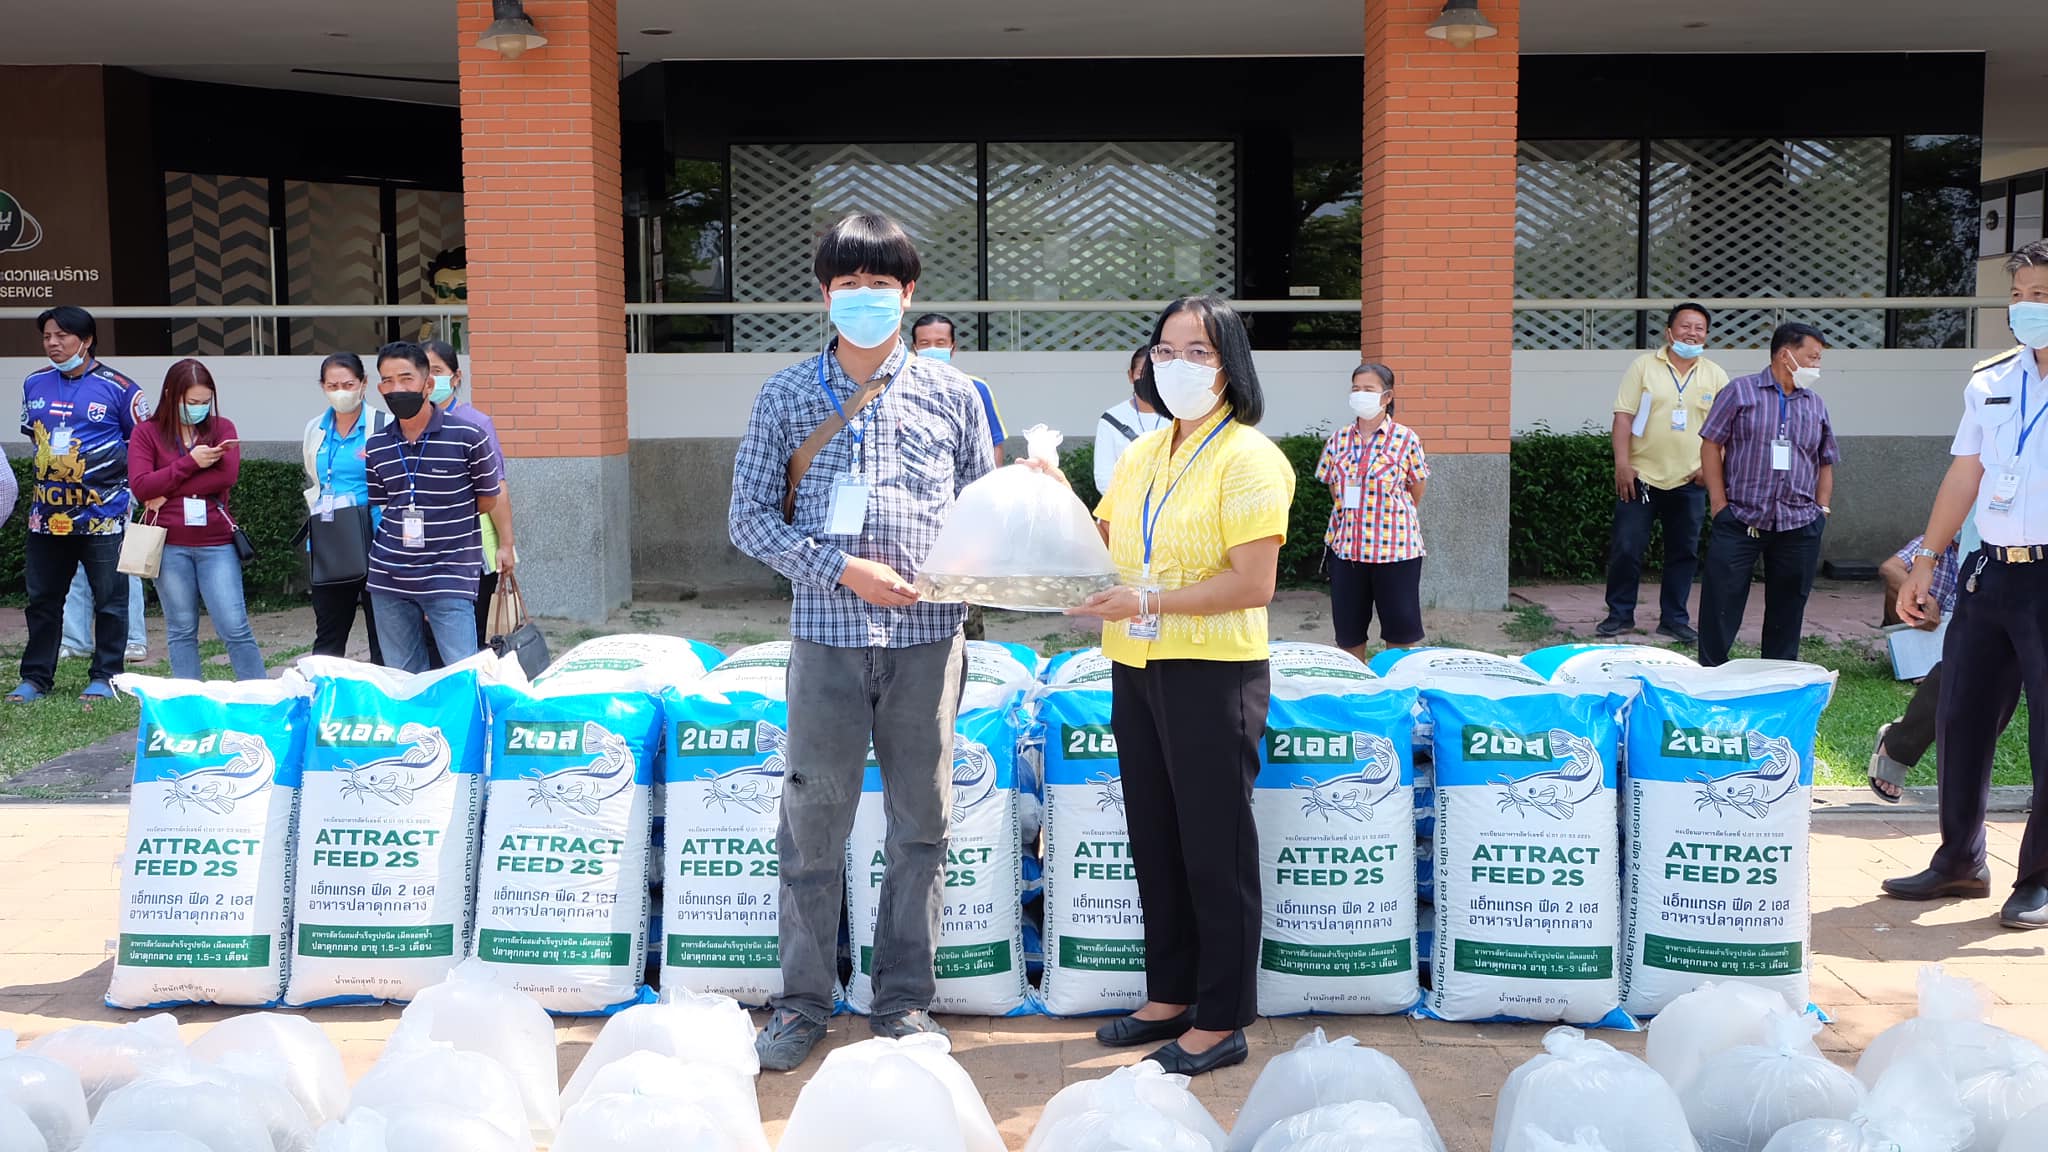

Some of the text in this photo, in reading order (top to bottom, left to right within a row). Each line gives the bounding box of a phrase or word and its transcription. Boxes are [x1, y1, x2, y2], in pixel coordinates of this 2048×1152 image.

[0, 286, 53, 298] SERVICE
[509, 727, 577, 749] 2เอส
[681, 728, 749, 749] 2เอส
[1069, 731, 1118, 752] 2เอ
[1273, 734, 1347, 757] 2เอส
[1470, 732, 1544, 756] 2เอส
[1668, 730, 1742, 755] 2เอส
[315, 829, 440, 846] ATTRACT
[500, 835, 624, 854] ATTRACT
[681, 838, 777, 854] ATTRAC
[138, 838, 260, 855] ATTRACT
[1278, 845, 1397, 864] ATTRACT
[1472, 844, 1600, 864] ATTRACT
[1666, 842, 1792, 863] ATTRACT
[314, 850, 419, 867] FEED 2S
[497, 856, 603, 875] FEED 2S
[135, 859, 237, 876] FEED 2S
[680, 860, 779, 876] FEED 2S
[1277, 867, 1383, 885] FEED 2S
[1472, 866, 1584, 886] FEED 2S
[1665, 863, 1777, 885] FEED 2S
[945, 870, 976, 887] 2S
[398, 884, 406, 896] 2
[413, 885, 434, 896] เอส
[582, 891, 589, 903] 2
[597, 892, 617, 903] เอส
[216, 894, 223, 905] 2
[231, 895, 253, 905] เอส
[763, 894, 771, 905] 2
[1368, 901, 1374, 913] 2
[1381, 900, 1397, 912] เอส
[1566, 901, 1573, 913] 2
[1580, 902, 1599, 914] เอส
[1759, 899, 1766, 911] 2
[1772, 899, 1789, 911] เอส
[678, 908, 777, 925] อาหารปลาดุกกล
[959, 904, 967, 915] 2
[974, 903, 993, 914] เอส
